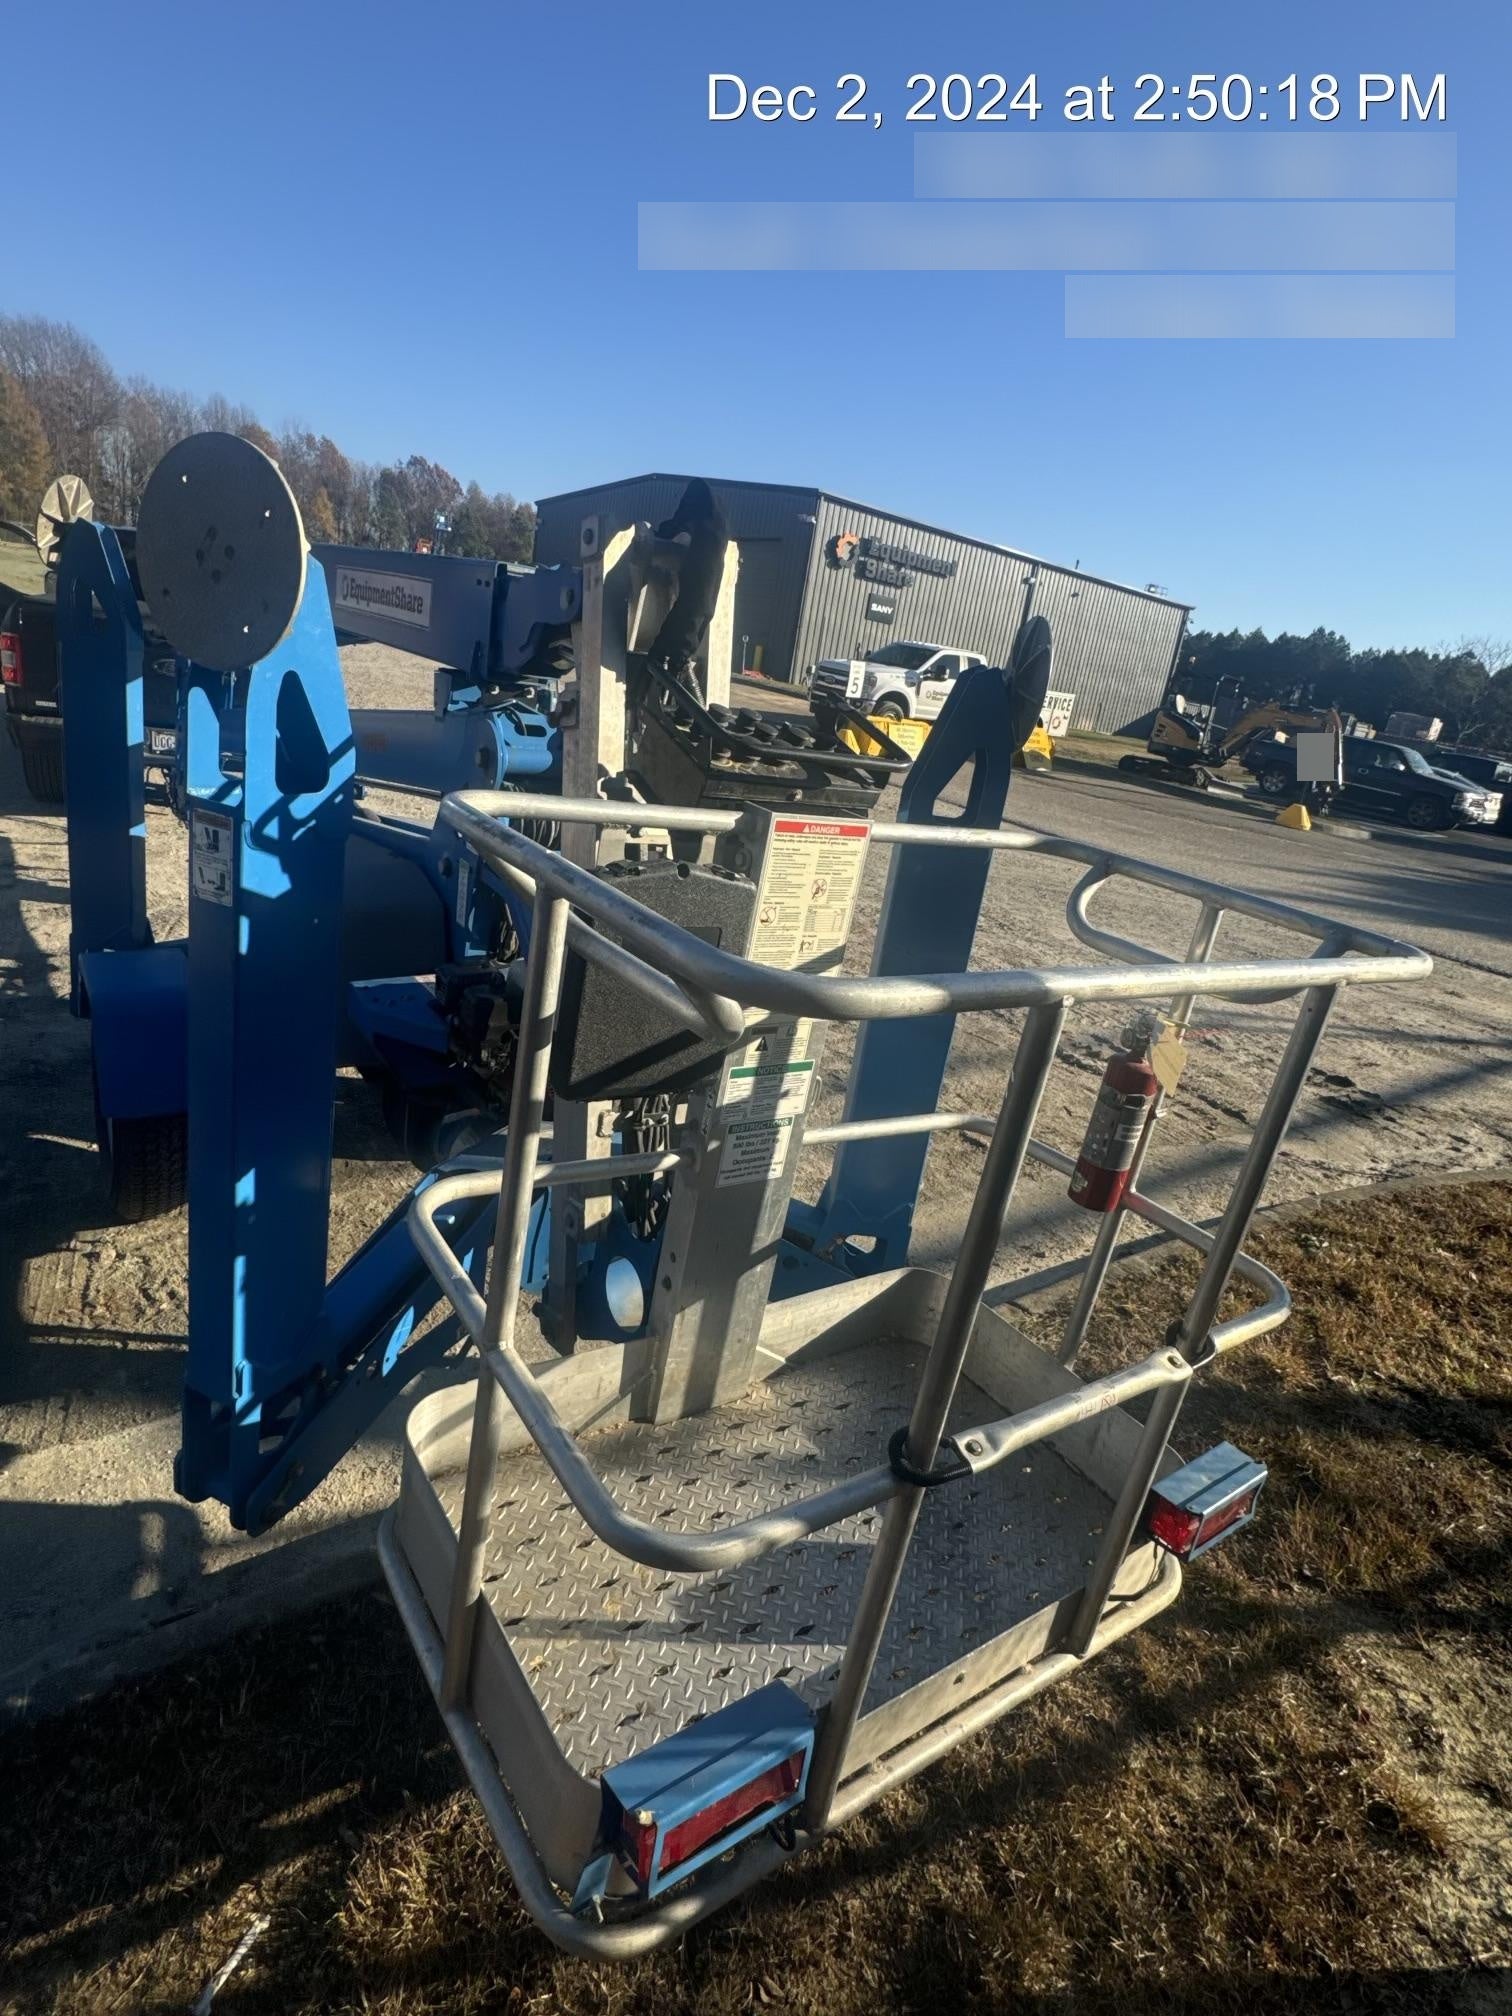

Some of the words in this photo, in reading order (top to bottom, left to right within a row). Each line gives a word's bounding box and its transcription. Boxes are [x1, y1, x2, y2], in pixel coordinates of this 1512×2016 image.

[350, 577, 424, 614] EquipmentShare
[871, 602, 894, 615] SANY
[810, 824, 841, 834] DANGER
